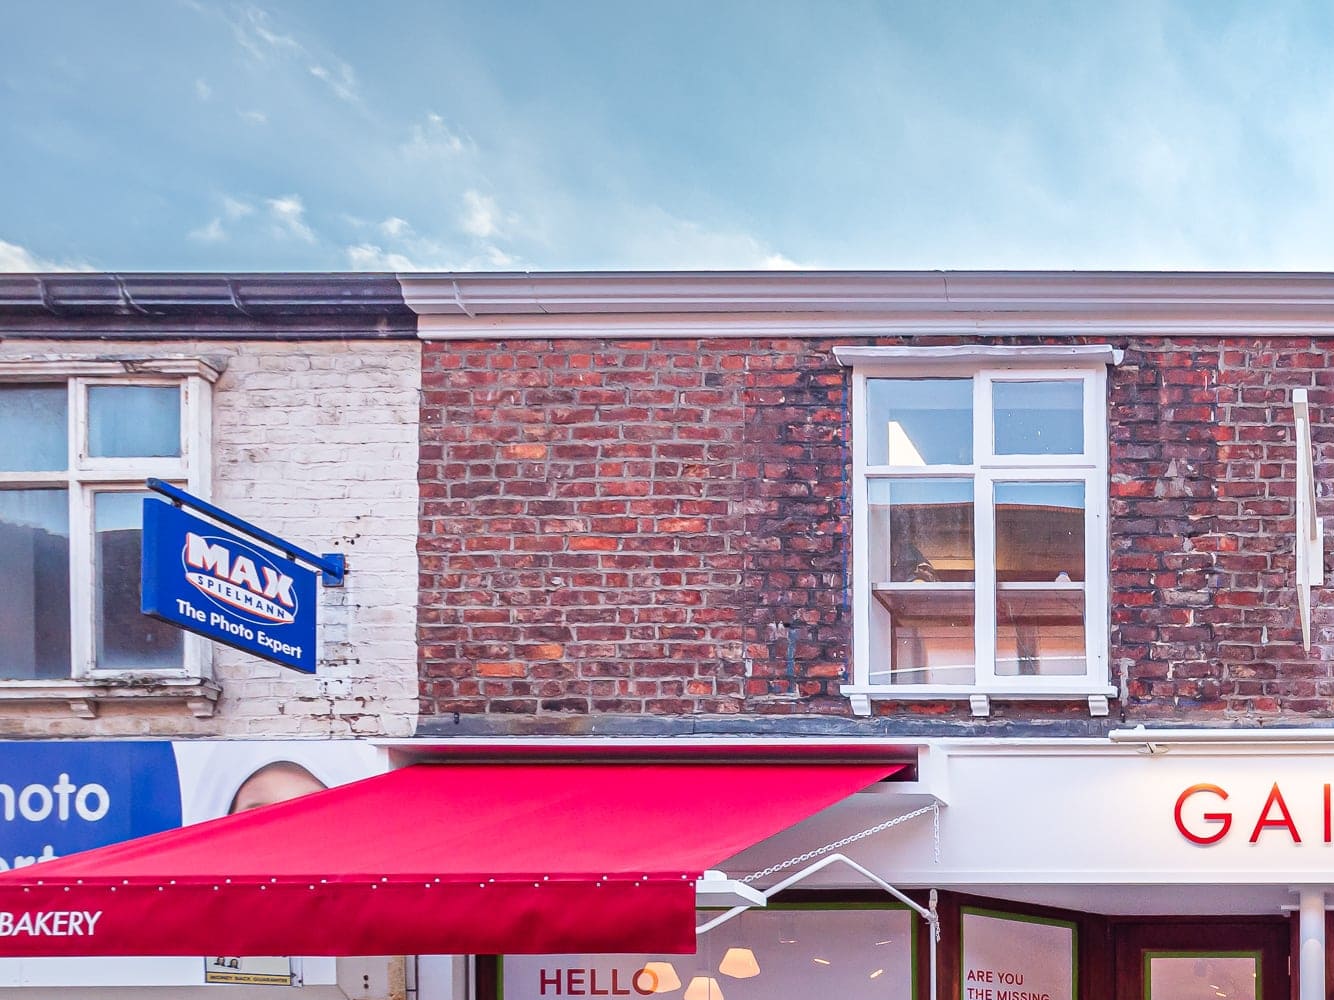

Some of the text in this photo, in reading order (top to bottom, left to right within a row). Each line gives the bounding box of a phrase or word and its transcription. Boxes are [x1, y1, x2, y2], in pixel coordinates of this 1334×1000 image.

[185, 532, 294, 608] MAX
[197, 575, 285, 619] SPIELMANN
[176, 599, 302, 659] The Photo Expert
[0, 911, 103, 936] BAKERY
[540, 968, 659, 996] HELLO
[967, 970, 1024, 985] ARE YOU
[967, 988, 992, 1000] THE
